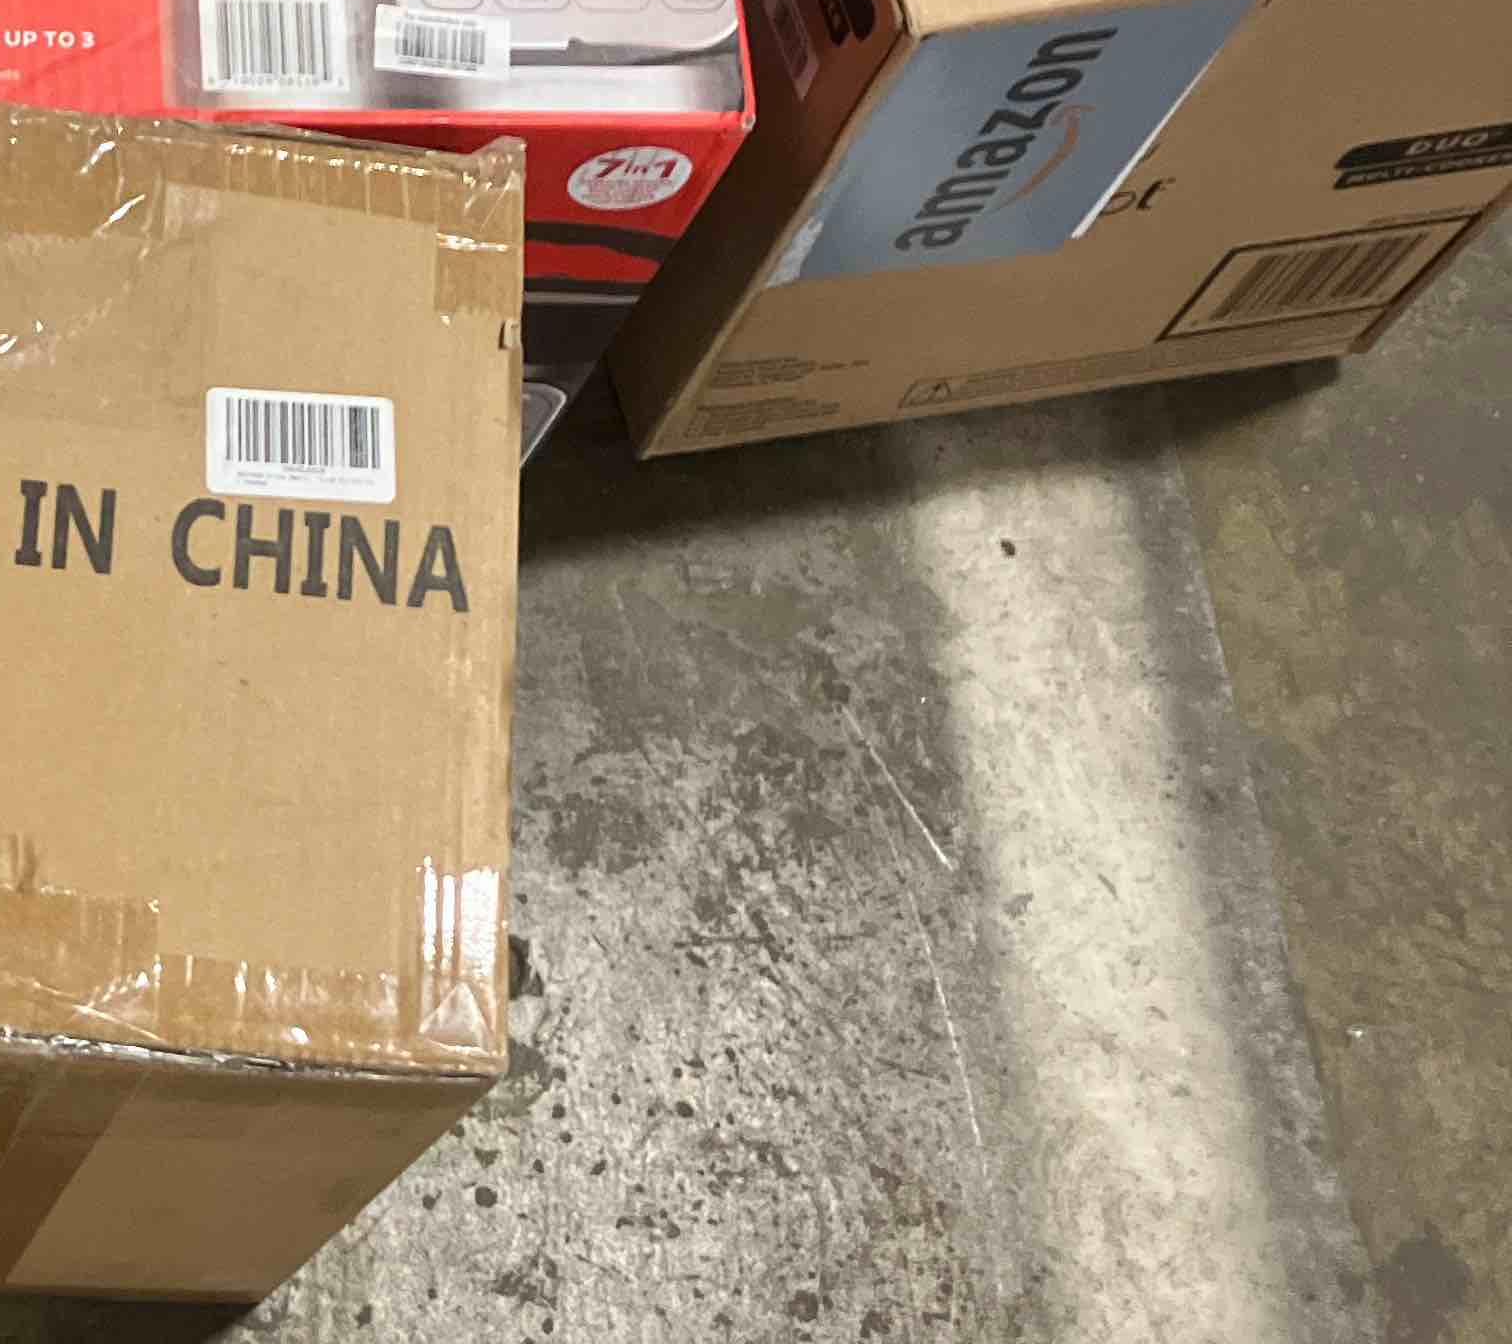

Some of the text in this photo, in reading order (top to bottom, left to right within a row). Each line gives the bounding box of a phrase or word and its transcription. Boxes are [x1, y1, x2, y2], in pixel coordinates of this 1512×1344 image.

[4, 29, 38, 48] UP
[42, 30, 75, 49] TO
[80, 30, 96, 49] 3
[894, 26, 1118, 252] amazon
[1404, 132, 1489, 156] DUO
[14, 479, 117, 576] IN
[170, 497, 470, 614] CHINA
